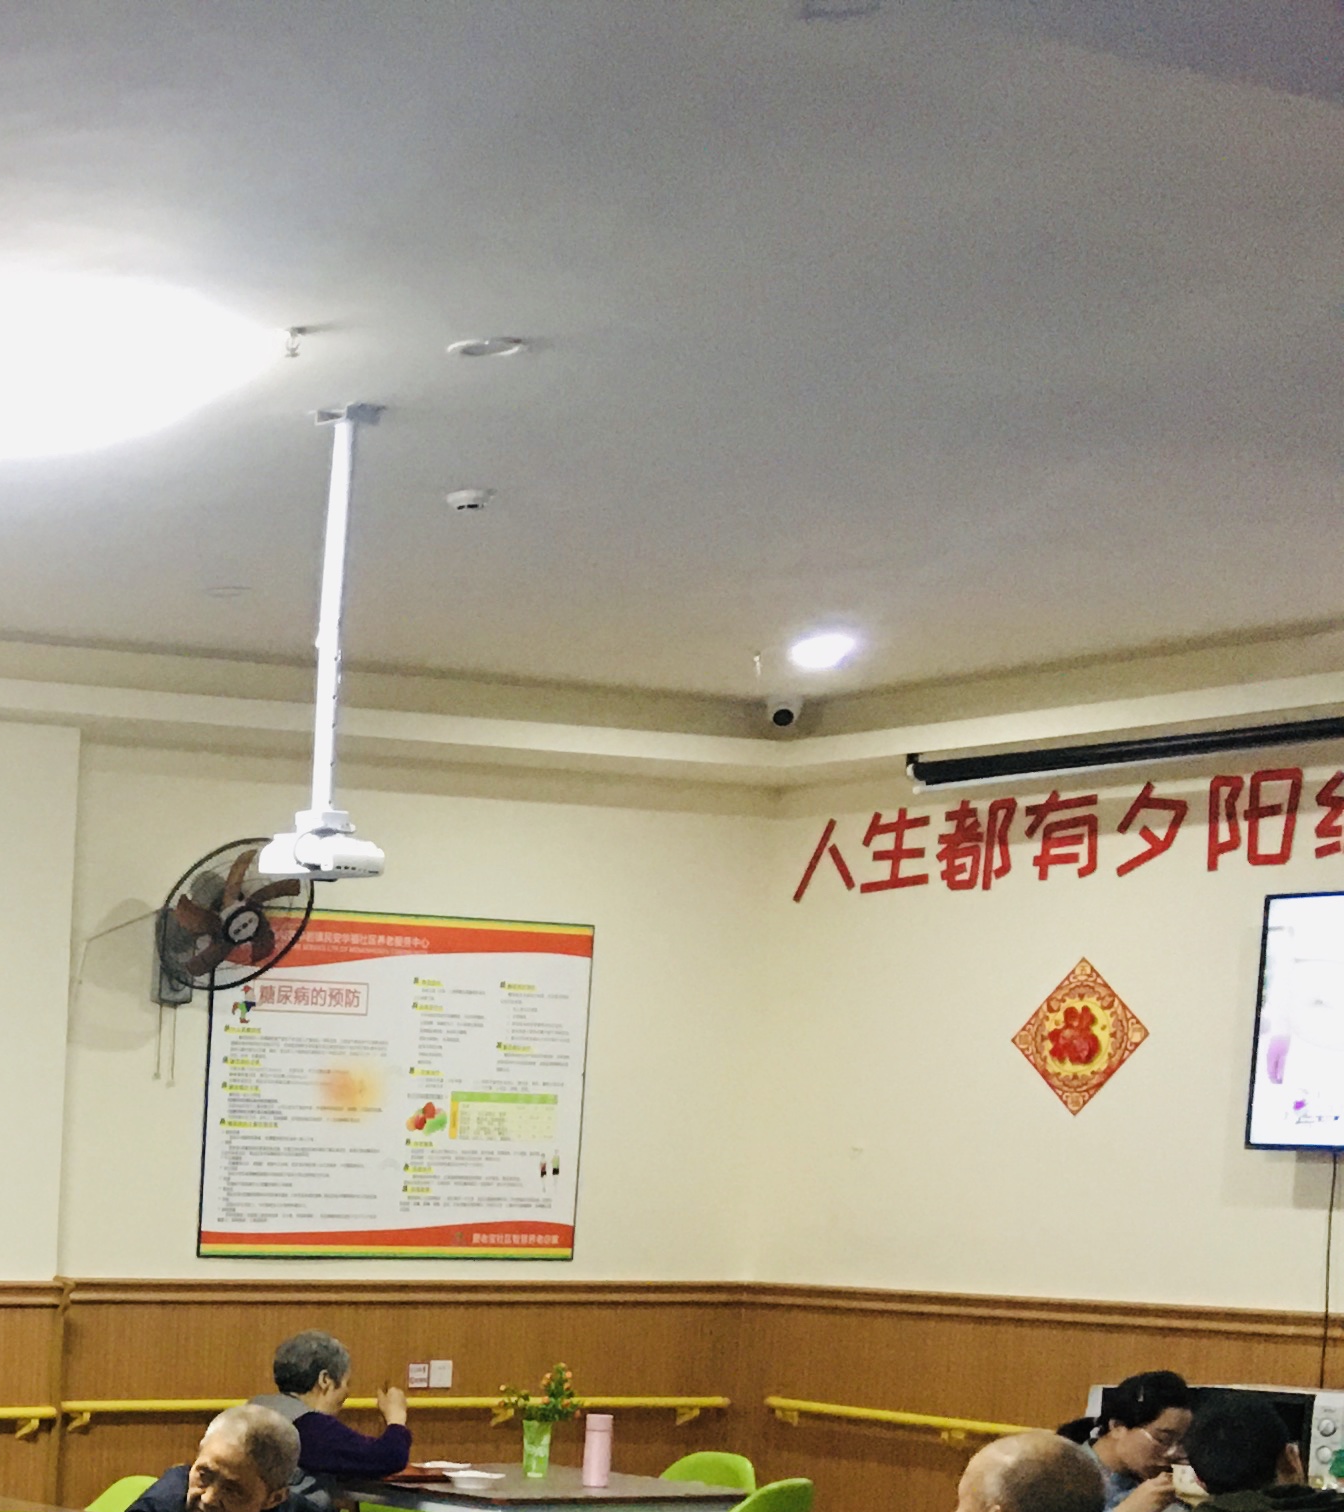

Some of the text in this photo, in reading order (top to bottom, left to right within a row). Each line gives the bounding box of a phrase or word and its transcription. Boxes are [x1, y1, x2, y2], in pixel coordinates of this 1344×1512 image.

[258, 984, 362, 1008] 糖尿病的预防
